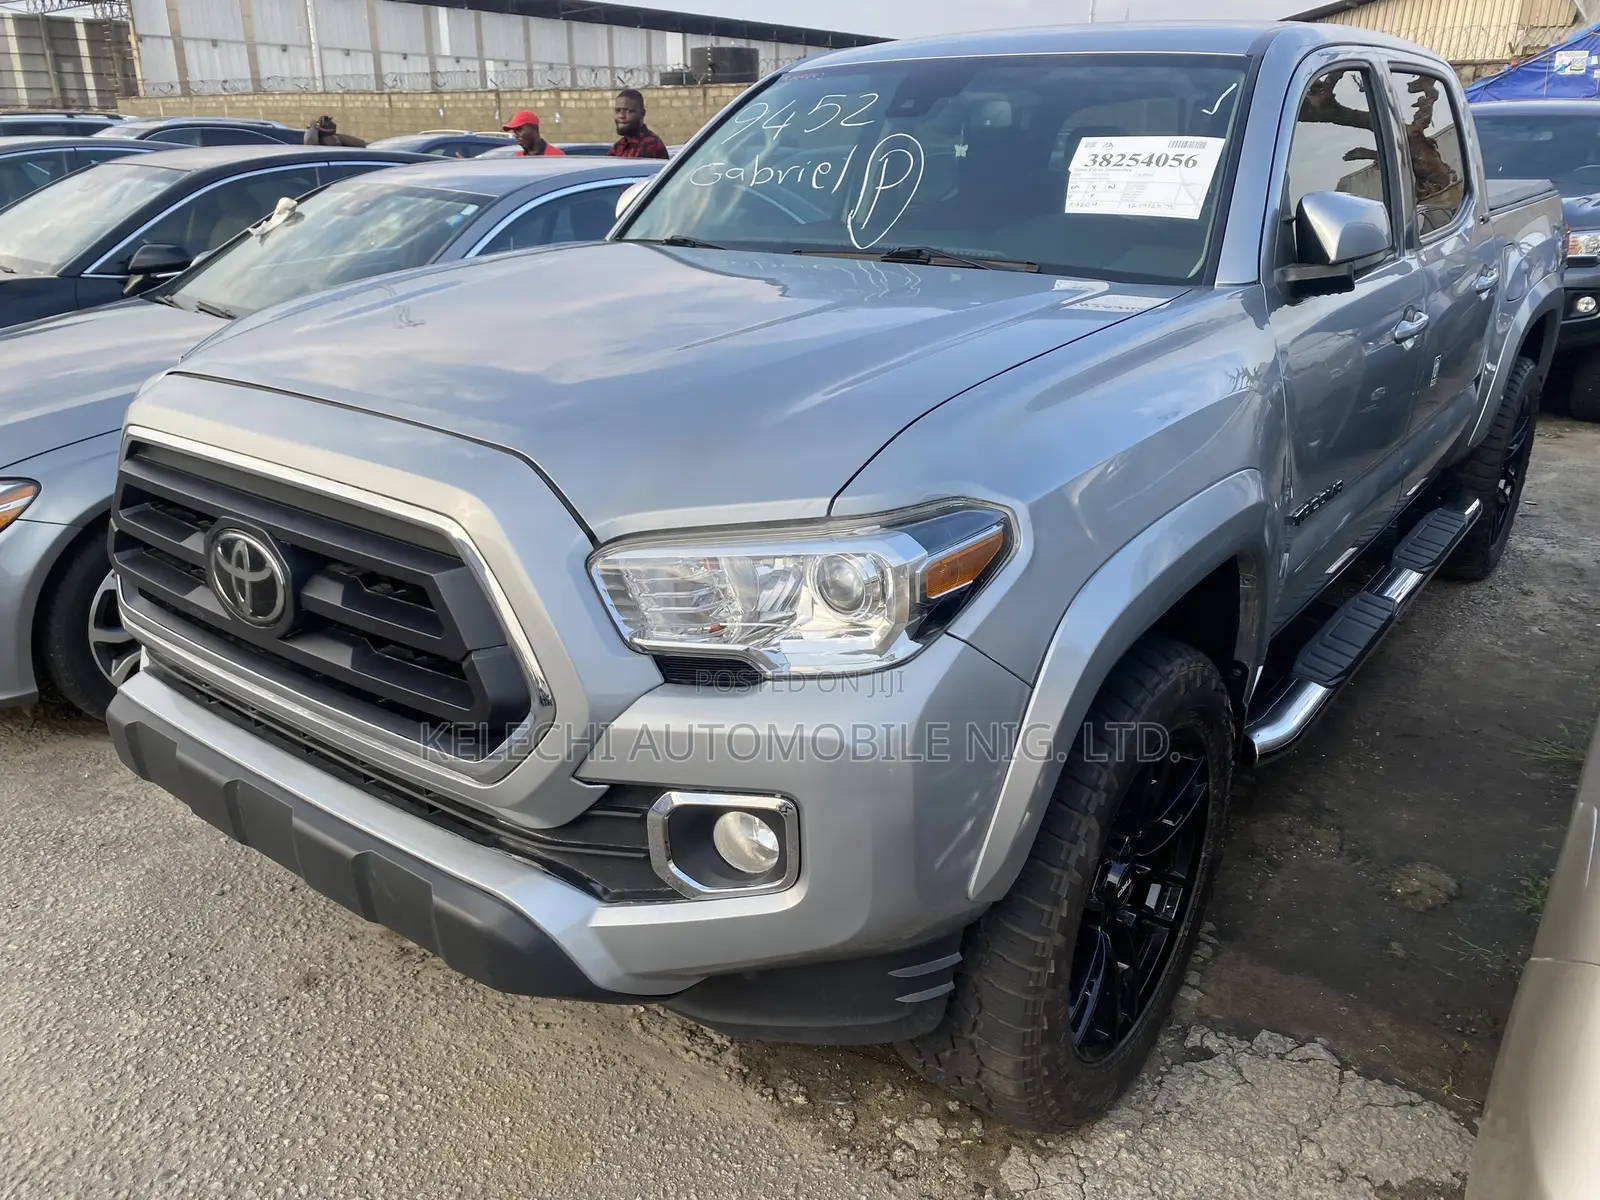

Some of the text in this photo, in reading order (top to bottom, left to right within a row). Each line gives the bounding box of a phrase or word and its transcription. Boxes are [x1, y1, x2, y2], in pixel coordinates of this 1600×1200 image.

[721, 93, 879, 144] 9452
[689, 144, 858, 194] Gabriel
[1084, 152, 1200, 169] 38254056
